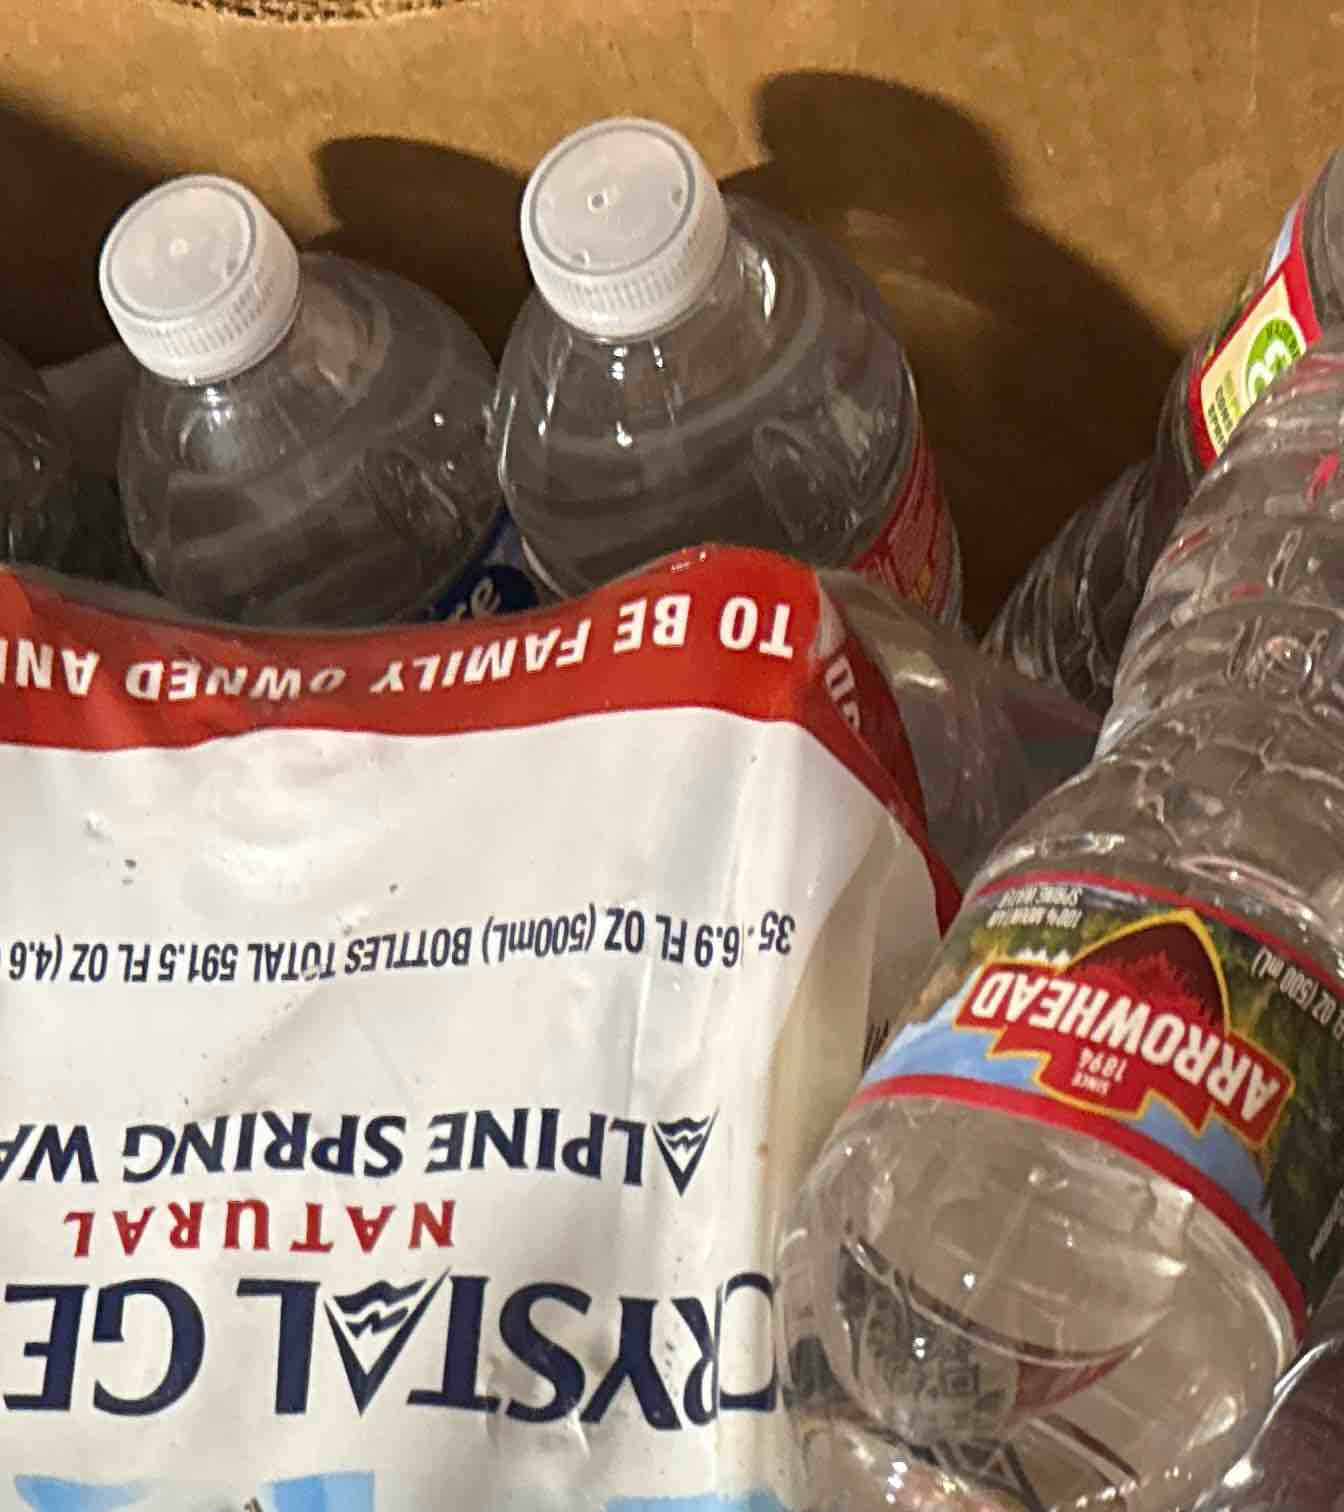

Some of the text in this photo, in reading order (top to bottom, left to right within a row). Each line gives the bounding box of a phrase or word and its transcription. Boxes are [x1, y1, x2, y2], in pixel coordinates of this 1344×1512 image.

[612, 593, 692, 654] BE
[718, 596, 794, 660] TO
[124, 658, 346, 701] OWNED
[370, 618, 591, 695] FAMILY
[345, 920, 472, 977] BOTTLES
[482, 903, 596, 966] (500mL)
[605, 908, 645, 954] OZ
[656, 913, 687, 964] FL
[694, 923, 744, 968] 6.9
[9, 933, 64, 982] (4.6
[70, 942, 109, 982] OZ
[119, 942, 149, 982] FL
[158, 943, 239, 982] 591.5
[248, 941, 336, 982] TOTAL
[1311, 990, 1338, 1026] OZ
[971, 968, 1282, 1124] ARROWHEAD
[1076, 1047, 1130, 1084] 1894
[1070, 1072, 1112, 1098] SINCE
[122, 1108, 407, 1183] SPRING
[425, 1106, 720, 1199] ALPINE
[62, 1198, 456, 1258] NATURAL
